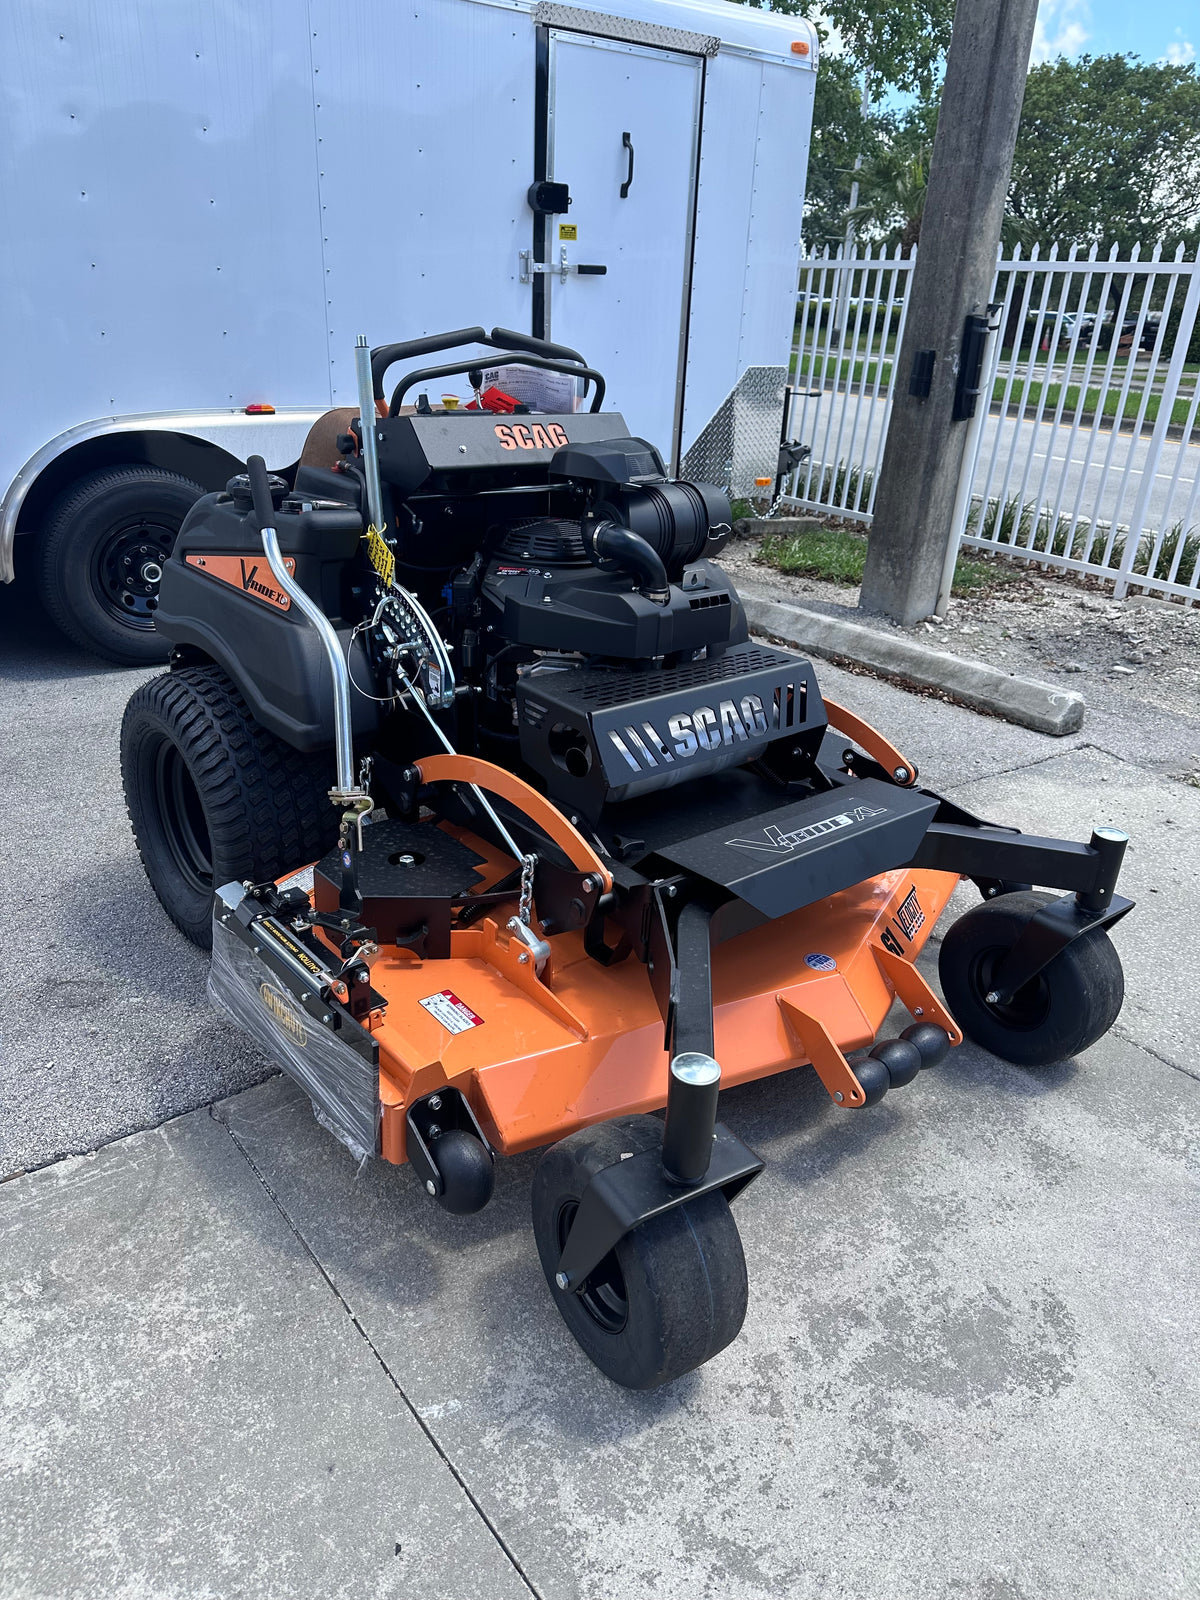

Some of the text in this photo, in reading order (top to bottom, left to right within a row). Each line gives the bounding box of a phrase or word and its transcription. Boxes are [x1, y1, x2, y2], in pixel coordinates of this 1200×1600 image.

[494, 423, 569, 450] SCAG
[668, 693, 768, 758] SCAG
[843, 806, 888, 822] XL
[892, 884, 922, 942] VELOCITY
[298, 953, 320, 973] CAUTION
[455, 1002, 476, 1020] DANGER
